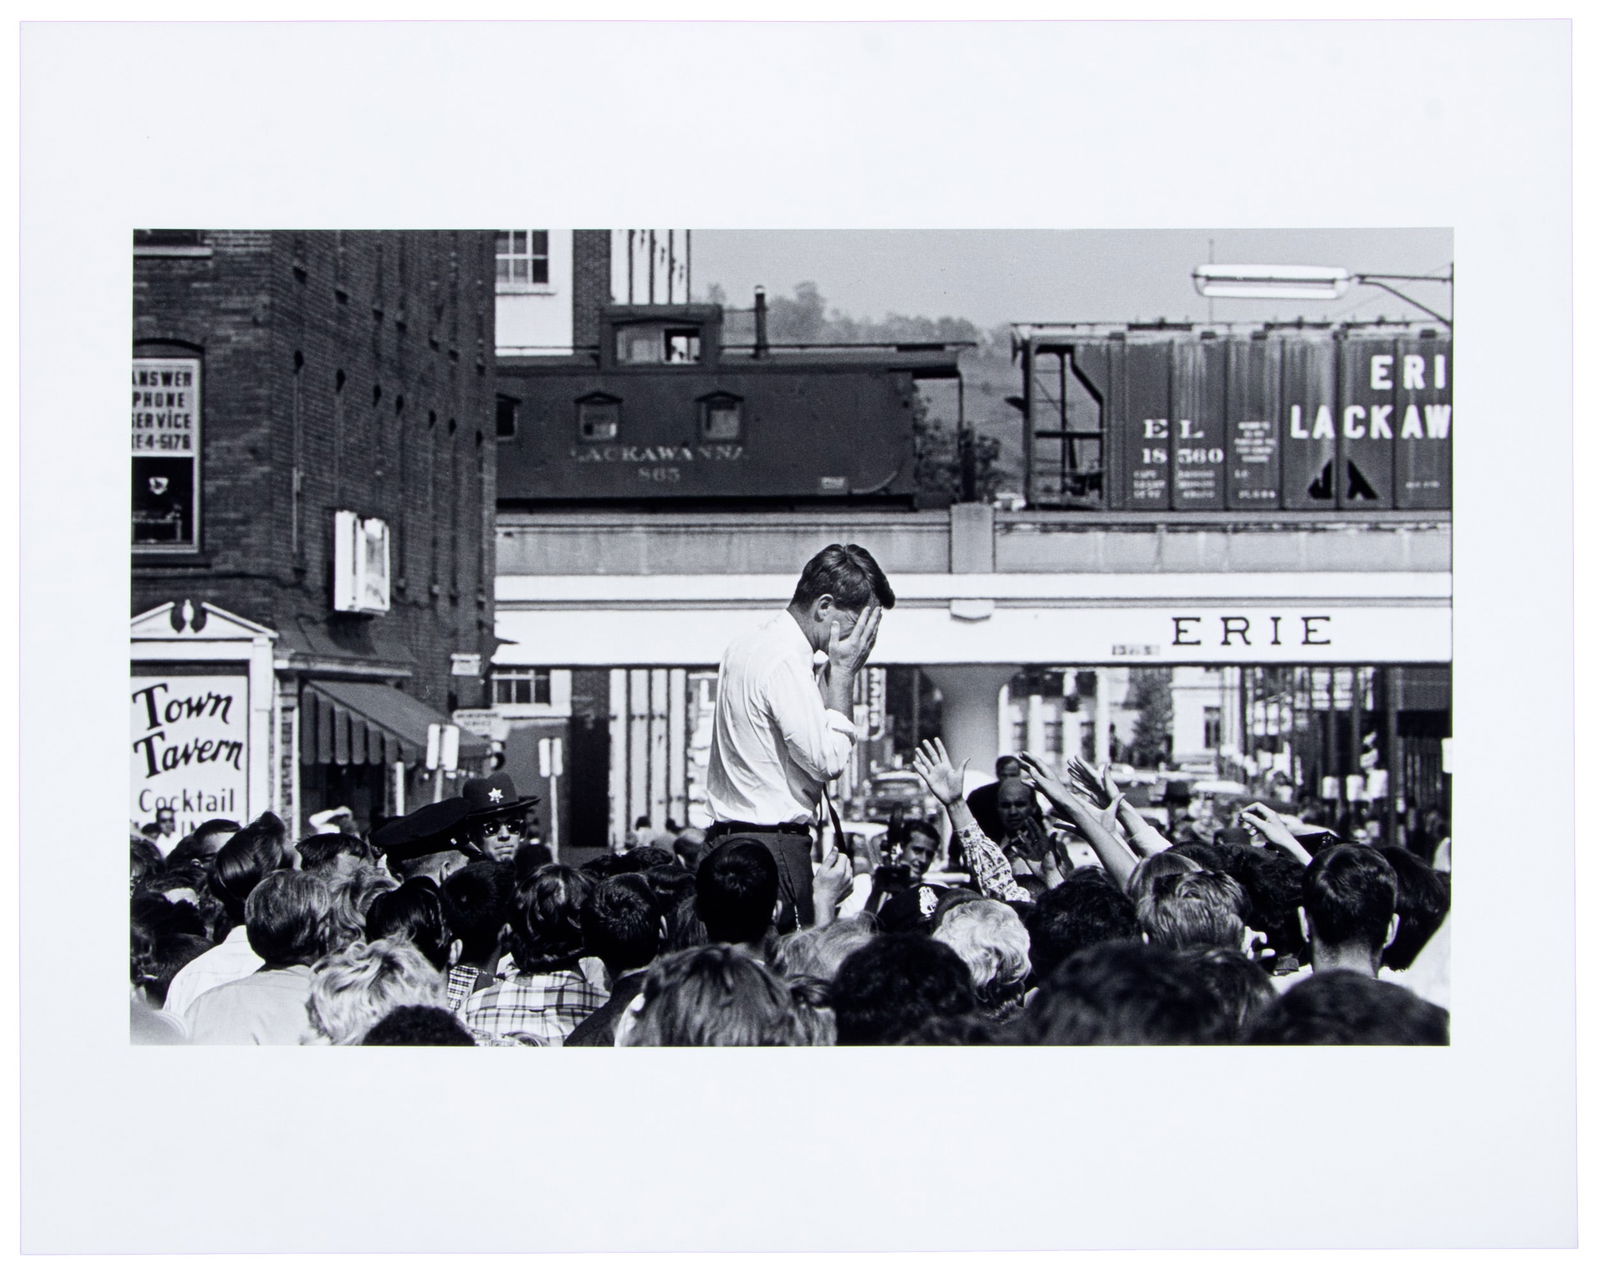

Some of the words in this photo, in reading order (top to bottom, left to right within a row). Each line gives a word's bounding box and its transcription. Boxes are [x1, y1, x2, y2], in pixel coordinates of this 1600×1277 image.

[1371, 354, 1446, 390] ERI
[132, 392, 185, 408] PHONE
[1290, 404, 1452, 440] LACKAW
[1171, 615, 1332, 646] ERIE
[132, 683, 233, 731] Town
[133, 731, 243, 779] Tavern
[139, 788, 234, 812] Cocktail
